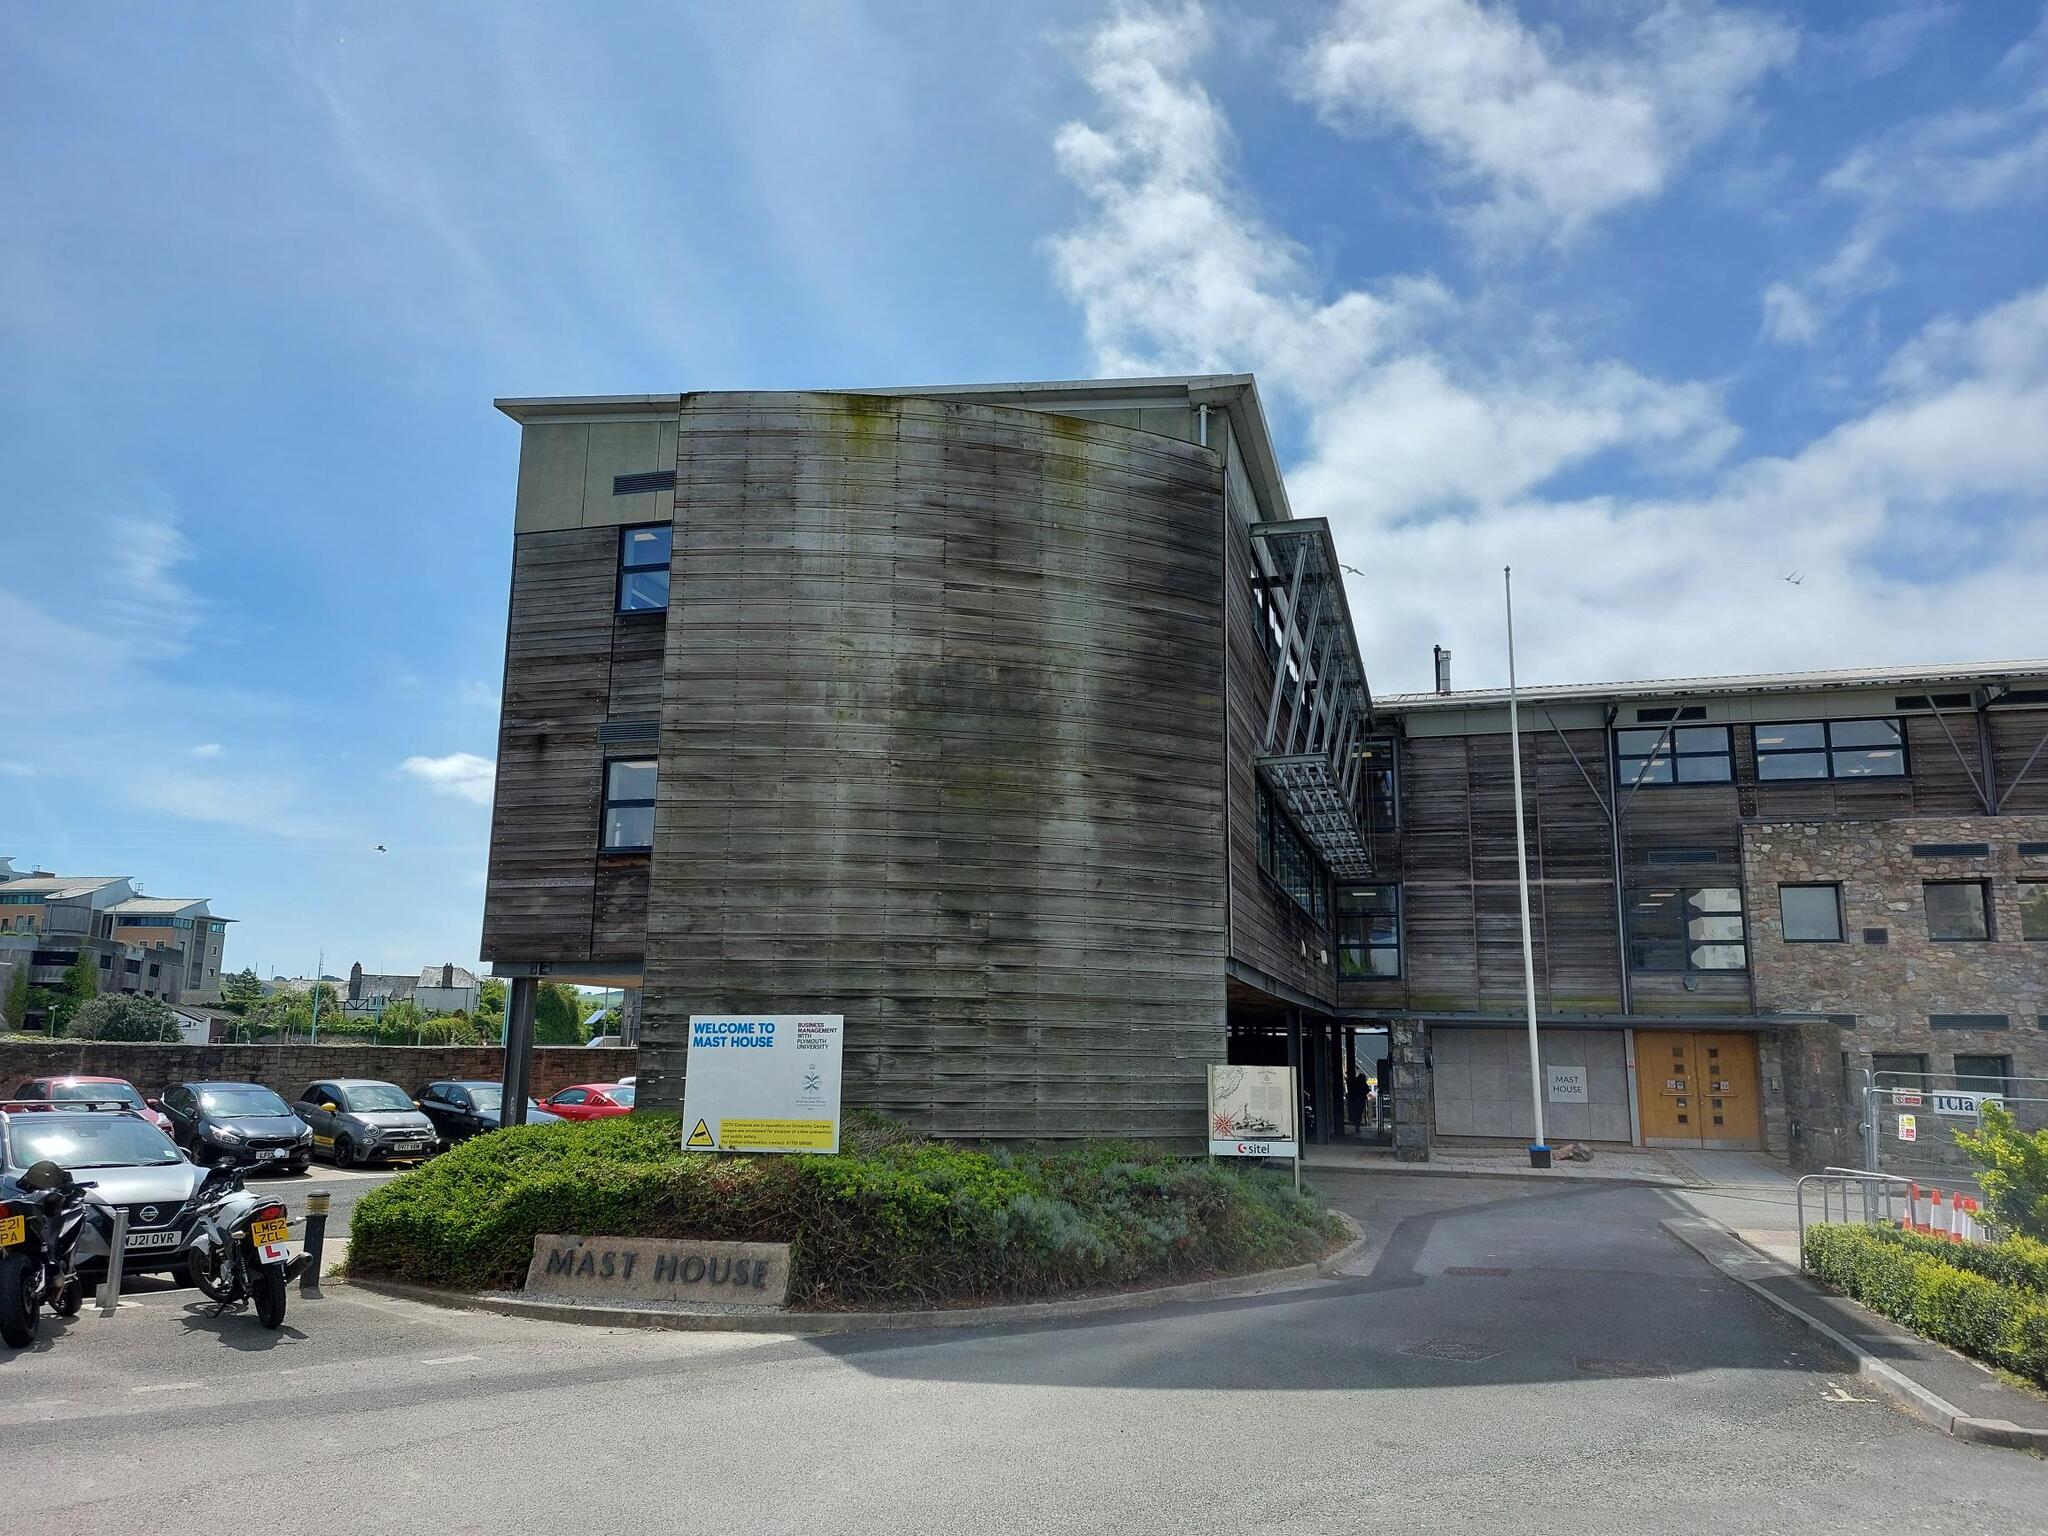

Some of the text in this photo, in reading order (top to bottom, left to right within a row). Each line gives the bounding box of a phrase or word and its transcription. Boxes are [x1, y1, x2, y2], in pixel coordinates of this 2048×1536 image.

[694, 1022, 775, 1034] WELCOME TO
[693, 1036, 774, 1048] MAST HOUSE
[1555, 1075, 1579, 1083] MAST
[1553, 1085, 1583, 1093] HOUSE
[1248, 1144, 1270, 1154] sitel
[253, 1219, 286, 1234] LM62
[259, 1231, 283, 1243] ZCL
[264, 1245, 281, 1259] L
[546, 1248, 769, 1288] MAST HOUSE
